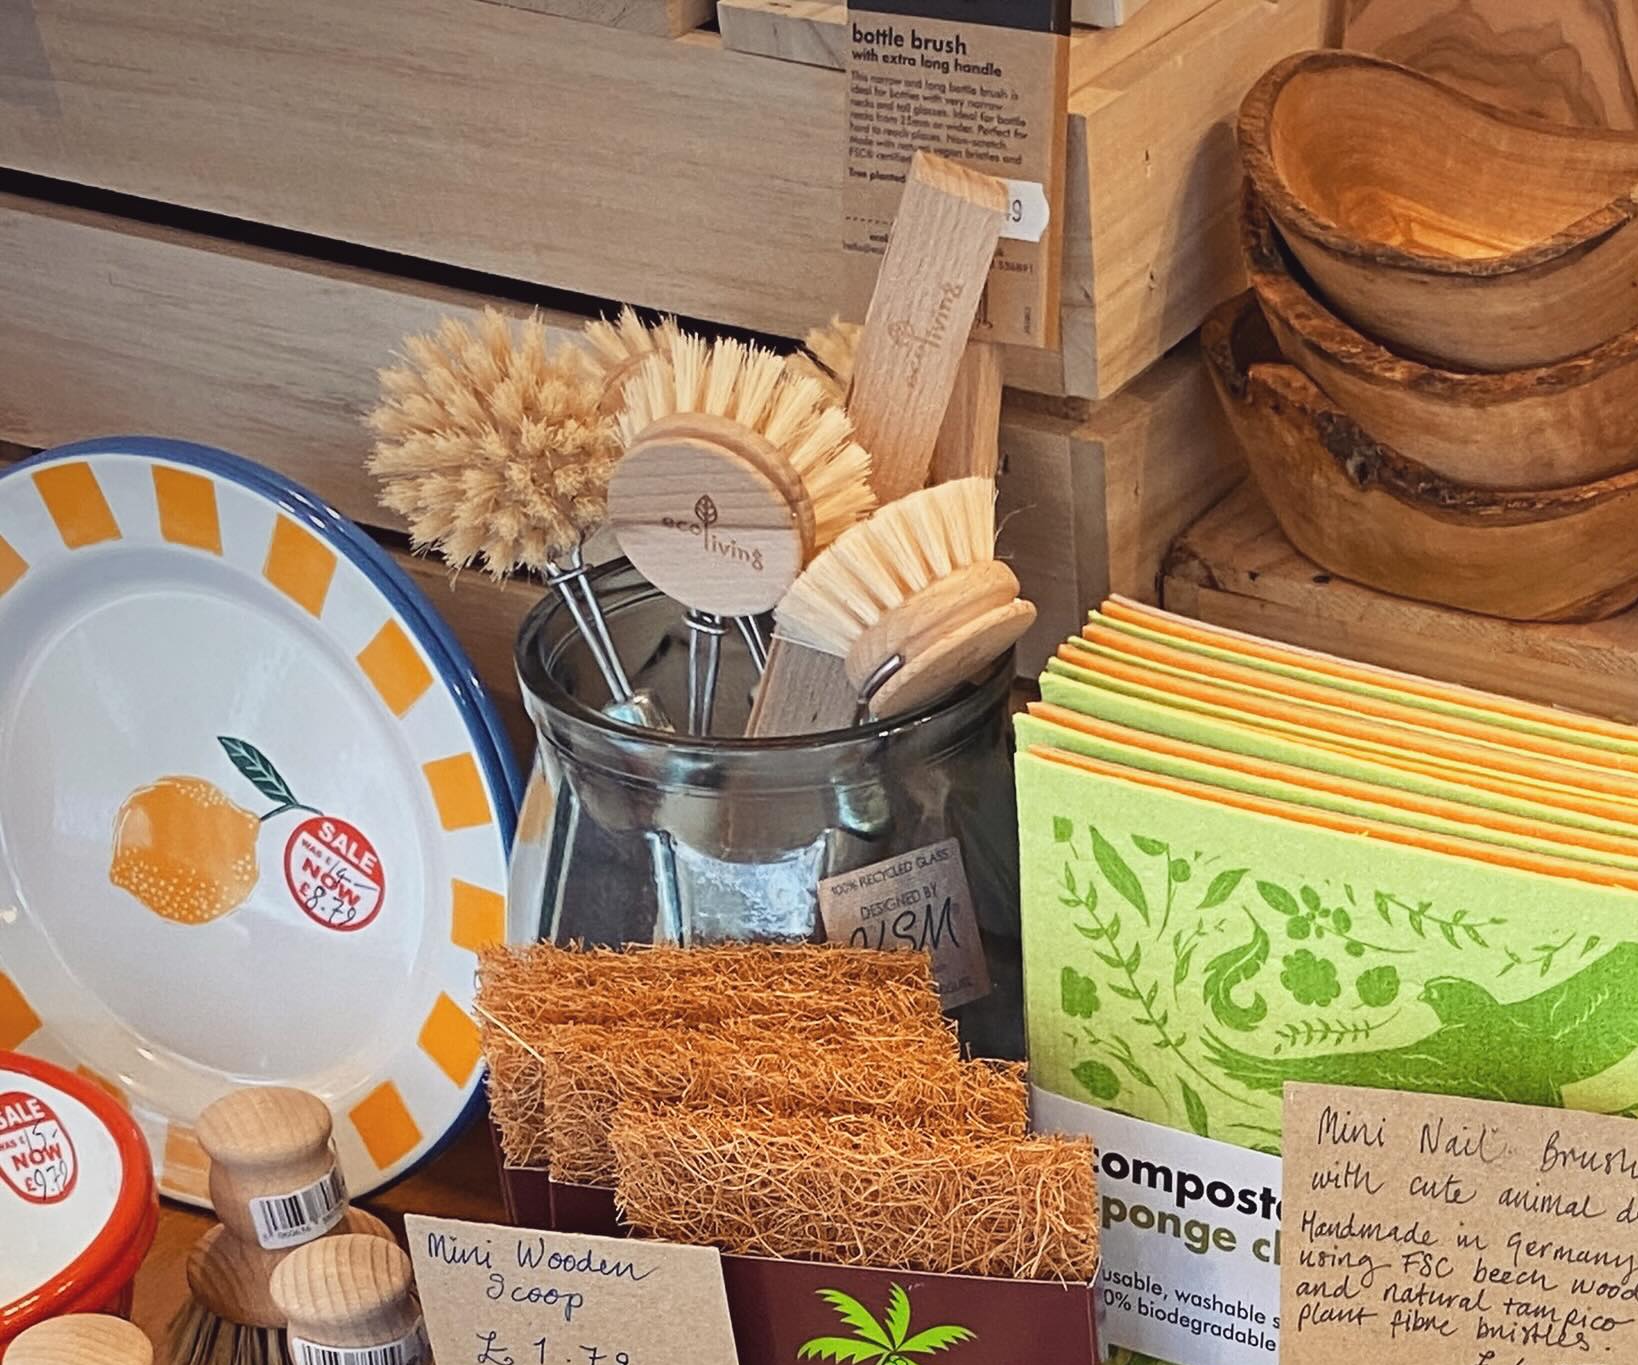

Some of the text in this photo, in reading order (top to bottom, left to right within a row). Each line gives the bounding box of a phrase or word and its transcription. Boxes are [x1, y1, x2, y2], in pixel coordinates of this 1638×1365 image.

[852, 23, 968, 55] bottle brush
[852, 49, 1002, 77] with extra long handle
[318, 820, 378, 876] SALE
[859, 861, 914, 889] RECYCLED
[916, 848, 951, 869] GLASS
[302, 857, 361, 907] NOW
[860, 881, 939, 921] DESIGNED BY
[11, 1142, 62, 1172] NOW
[1317, 1105, 1388, 1149] Mini
[1419, 1121, 1501, 1164] Nail
[1310, 1161, 1386, 1195] with
[1409, 1174, 1477, 1205] cute
[1498, 1181, 1607, 1222] animal
[1300, 1210, 1440, 1247] Handmade
[1455, 1222, 1490, 1251] in
[428, 1231, 661, 1282] Mini Wooden
[1299, 1248, 1392, 1288] using
[1401, 1251, 1455, 1278] FSC
[1472, 1263, 1559, 1293] beech
[485, 1273, 584, 1322] Scoop
[1174, 1290, 1267, 1326] washable
[1295, 1276, 1635, 1334] and natural tampico
[1136, 1298, 1278, 1353] biodegradable
[1390, 1308, 1458, 1339] fibre
